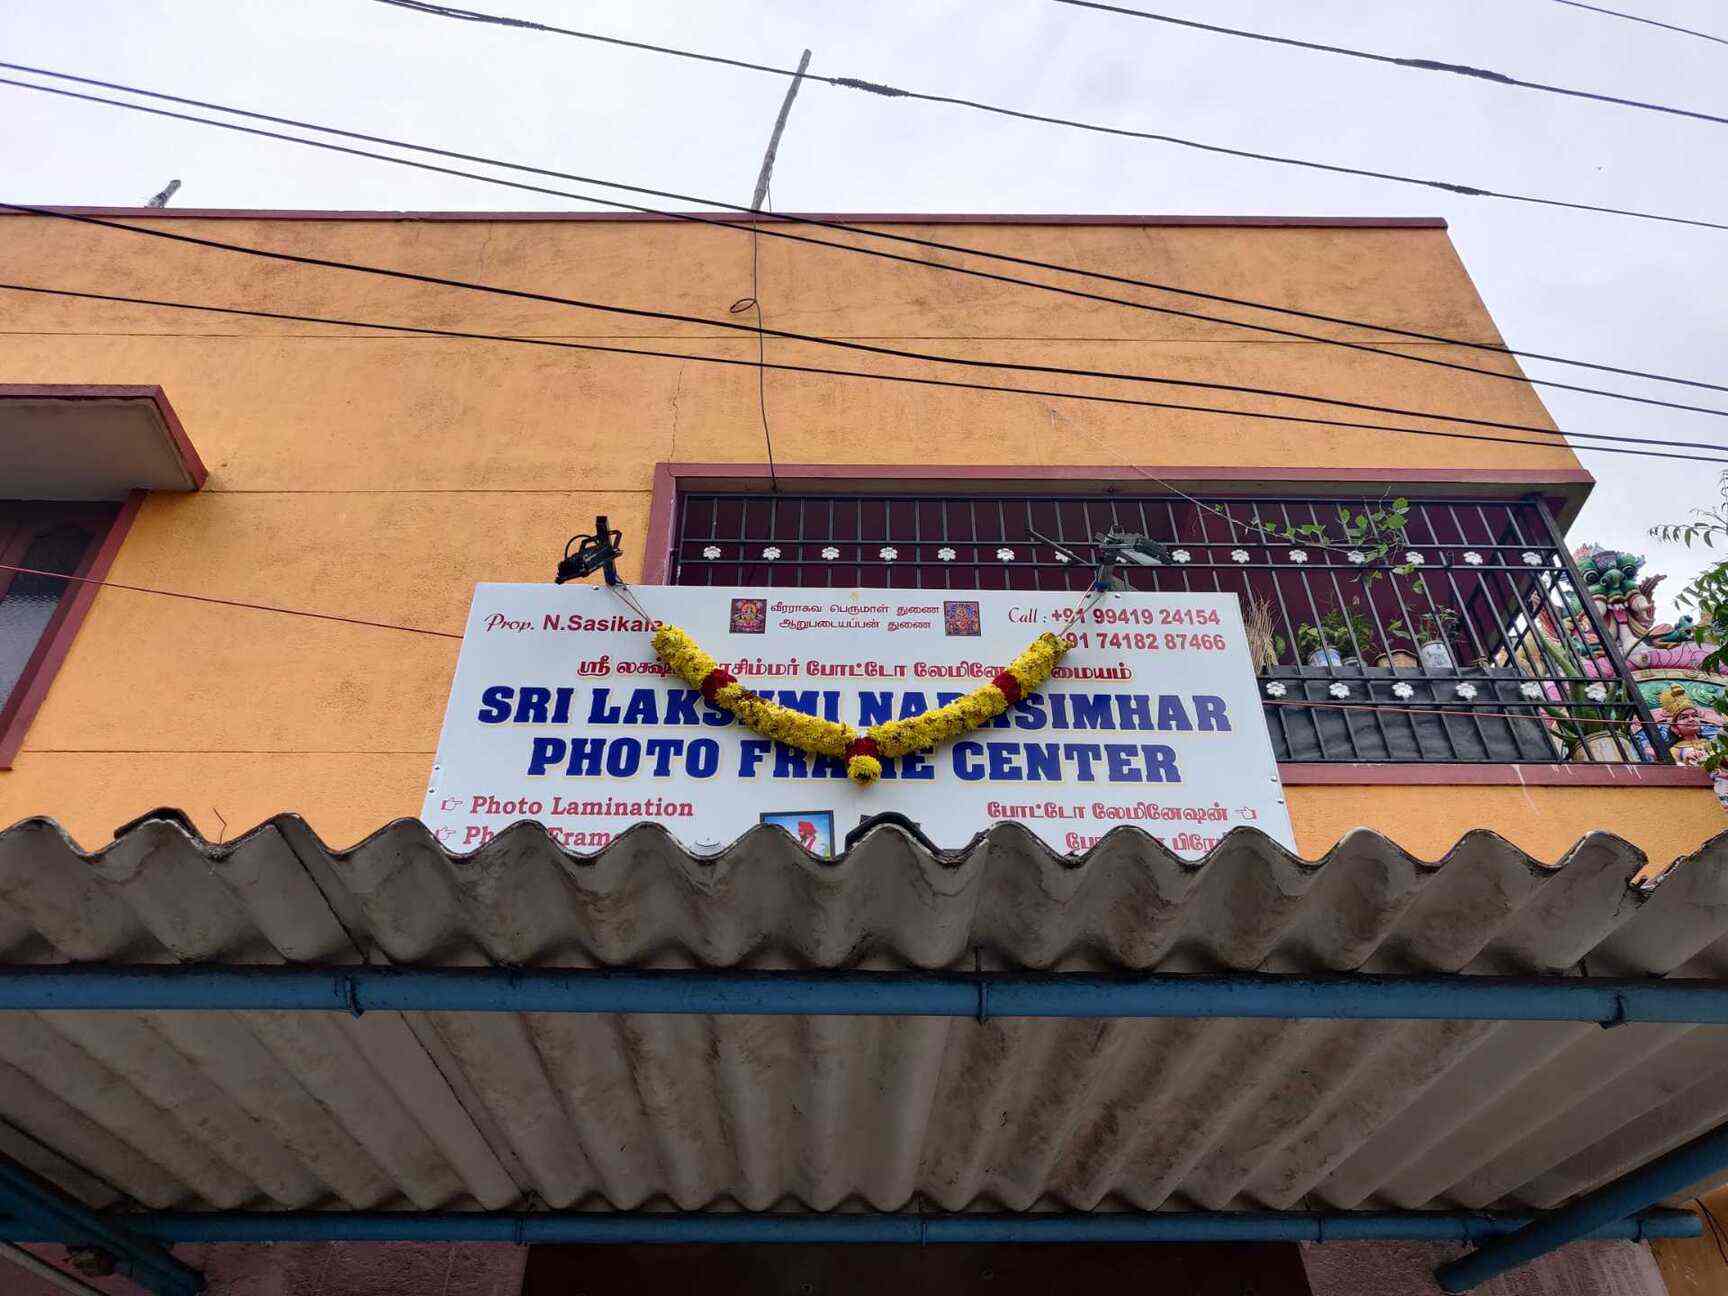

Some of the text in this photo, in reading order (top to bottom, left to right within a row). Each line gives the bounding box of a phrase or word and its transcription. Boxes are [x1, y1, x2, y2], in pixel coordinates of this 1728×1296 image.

[830, 602, 890, 616] பெருமாள்
[896, 604, 940, 617] துணை
[1008, 607, 1038, 624] Call
[1093, 608, 1154, 625] 99419
[1160, 609, 1221, 626] 24154
[485, 613, 534, 632] Prop.
[887, 621, 931, 633] துணை
[1097, 632, 1160, 650] 74182
[1164, 634, 1226, 651] 87466
[806, 661, 905, 677] போட்டோ
[478, 686, 574, 724] SRI
[527, 737, 719, 778] PHOTO
[953, 740, 1181, 783] CENTER
[470, 795, 694, 816] Photo Lamination
[987, 801, 1228, 824] போட்டோ லேமினேஷன்
